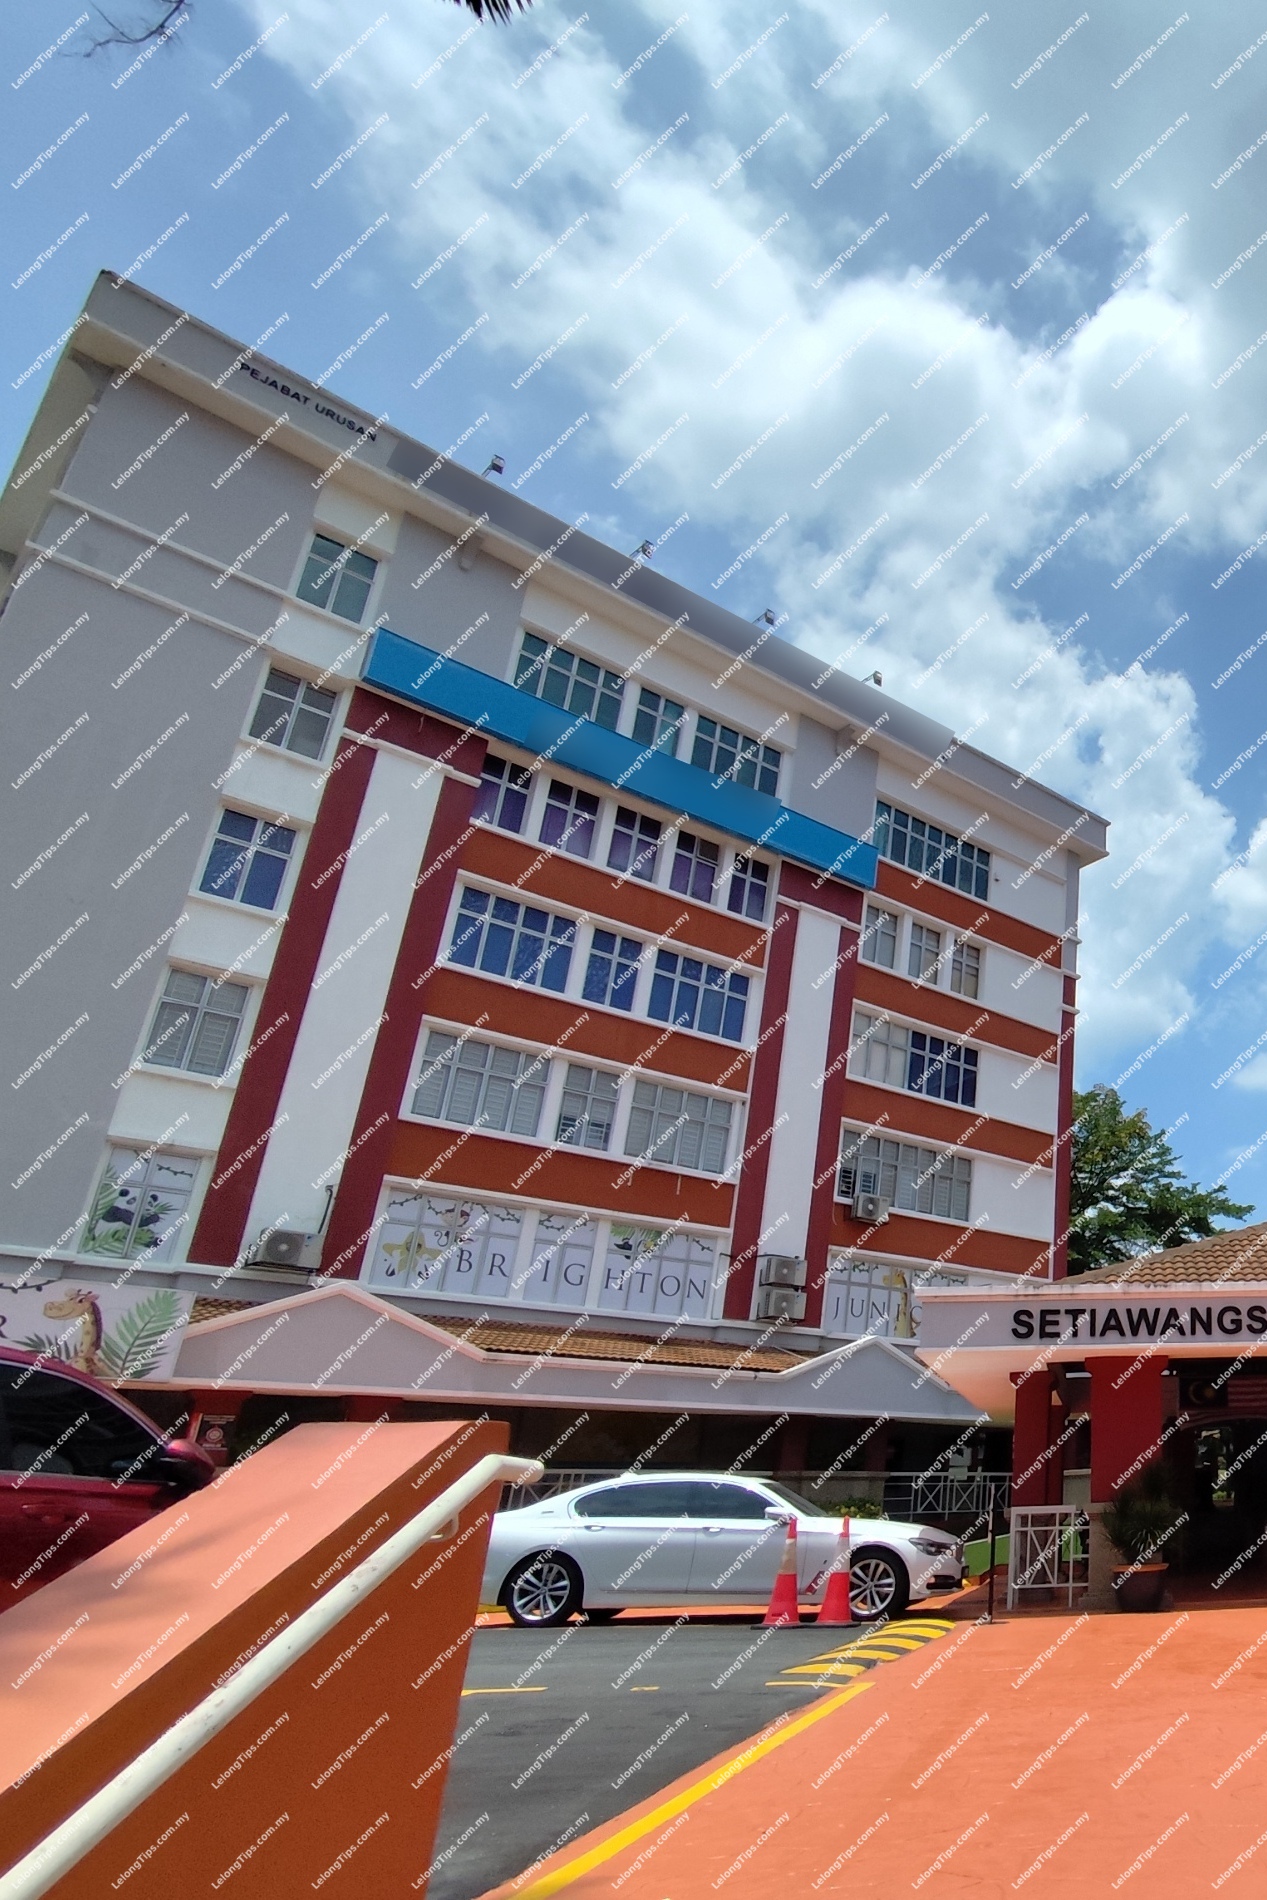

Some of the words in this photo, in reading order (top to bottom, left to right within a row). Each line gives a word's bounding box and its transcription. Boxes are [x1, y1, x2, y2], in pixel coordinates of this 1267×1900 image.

[239, 362, 310, 405] PEJABAT
[315, 402, 377, 442] URUSAN
[455, 1249, 707, 1300] BRIGHTON
